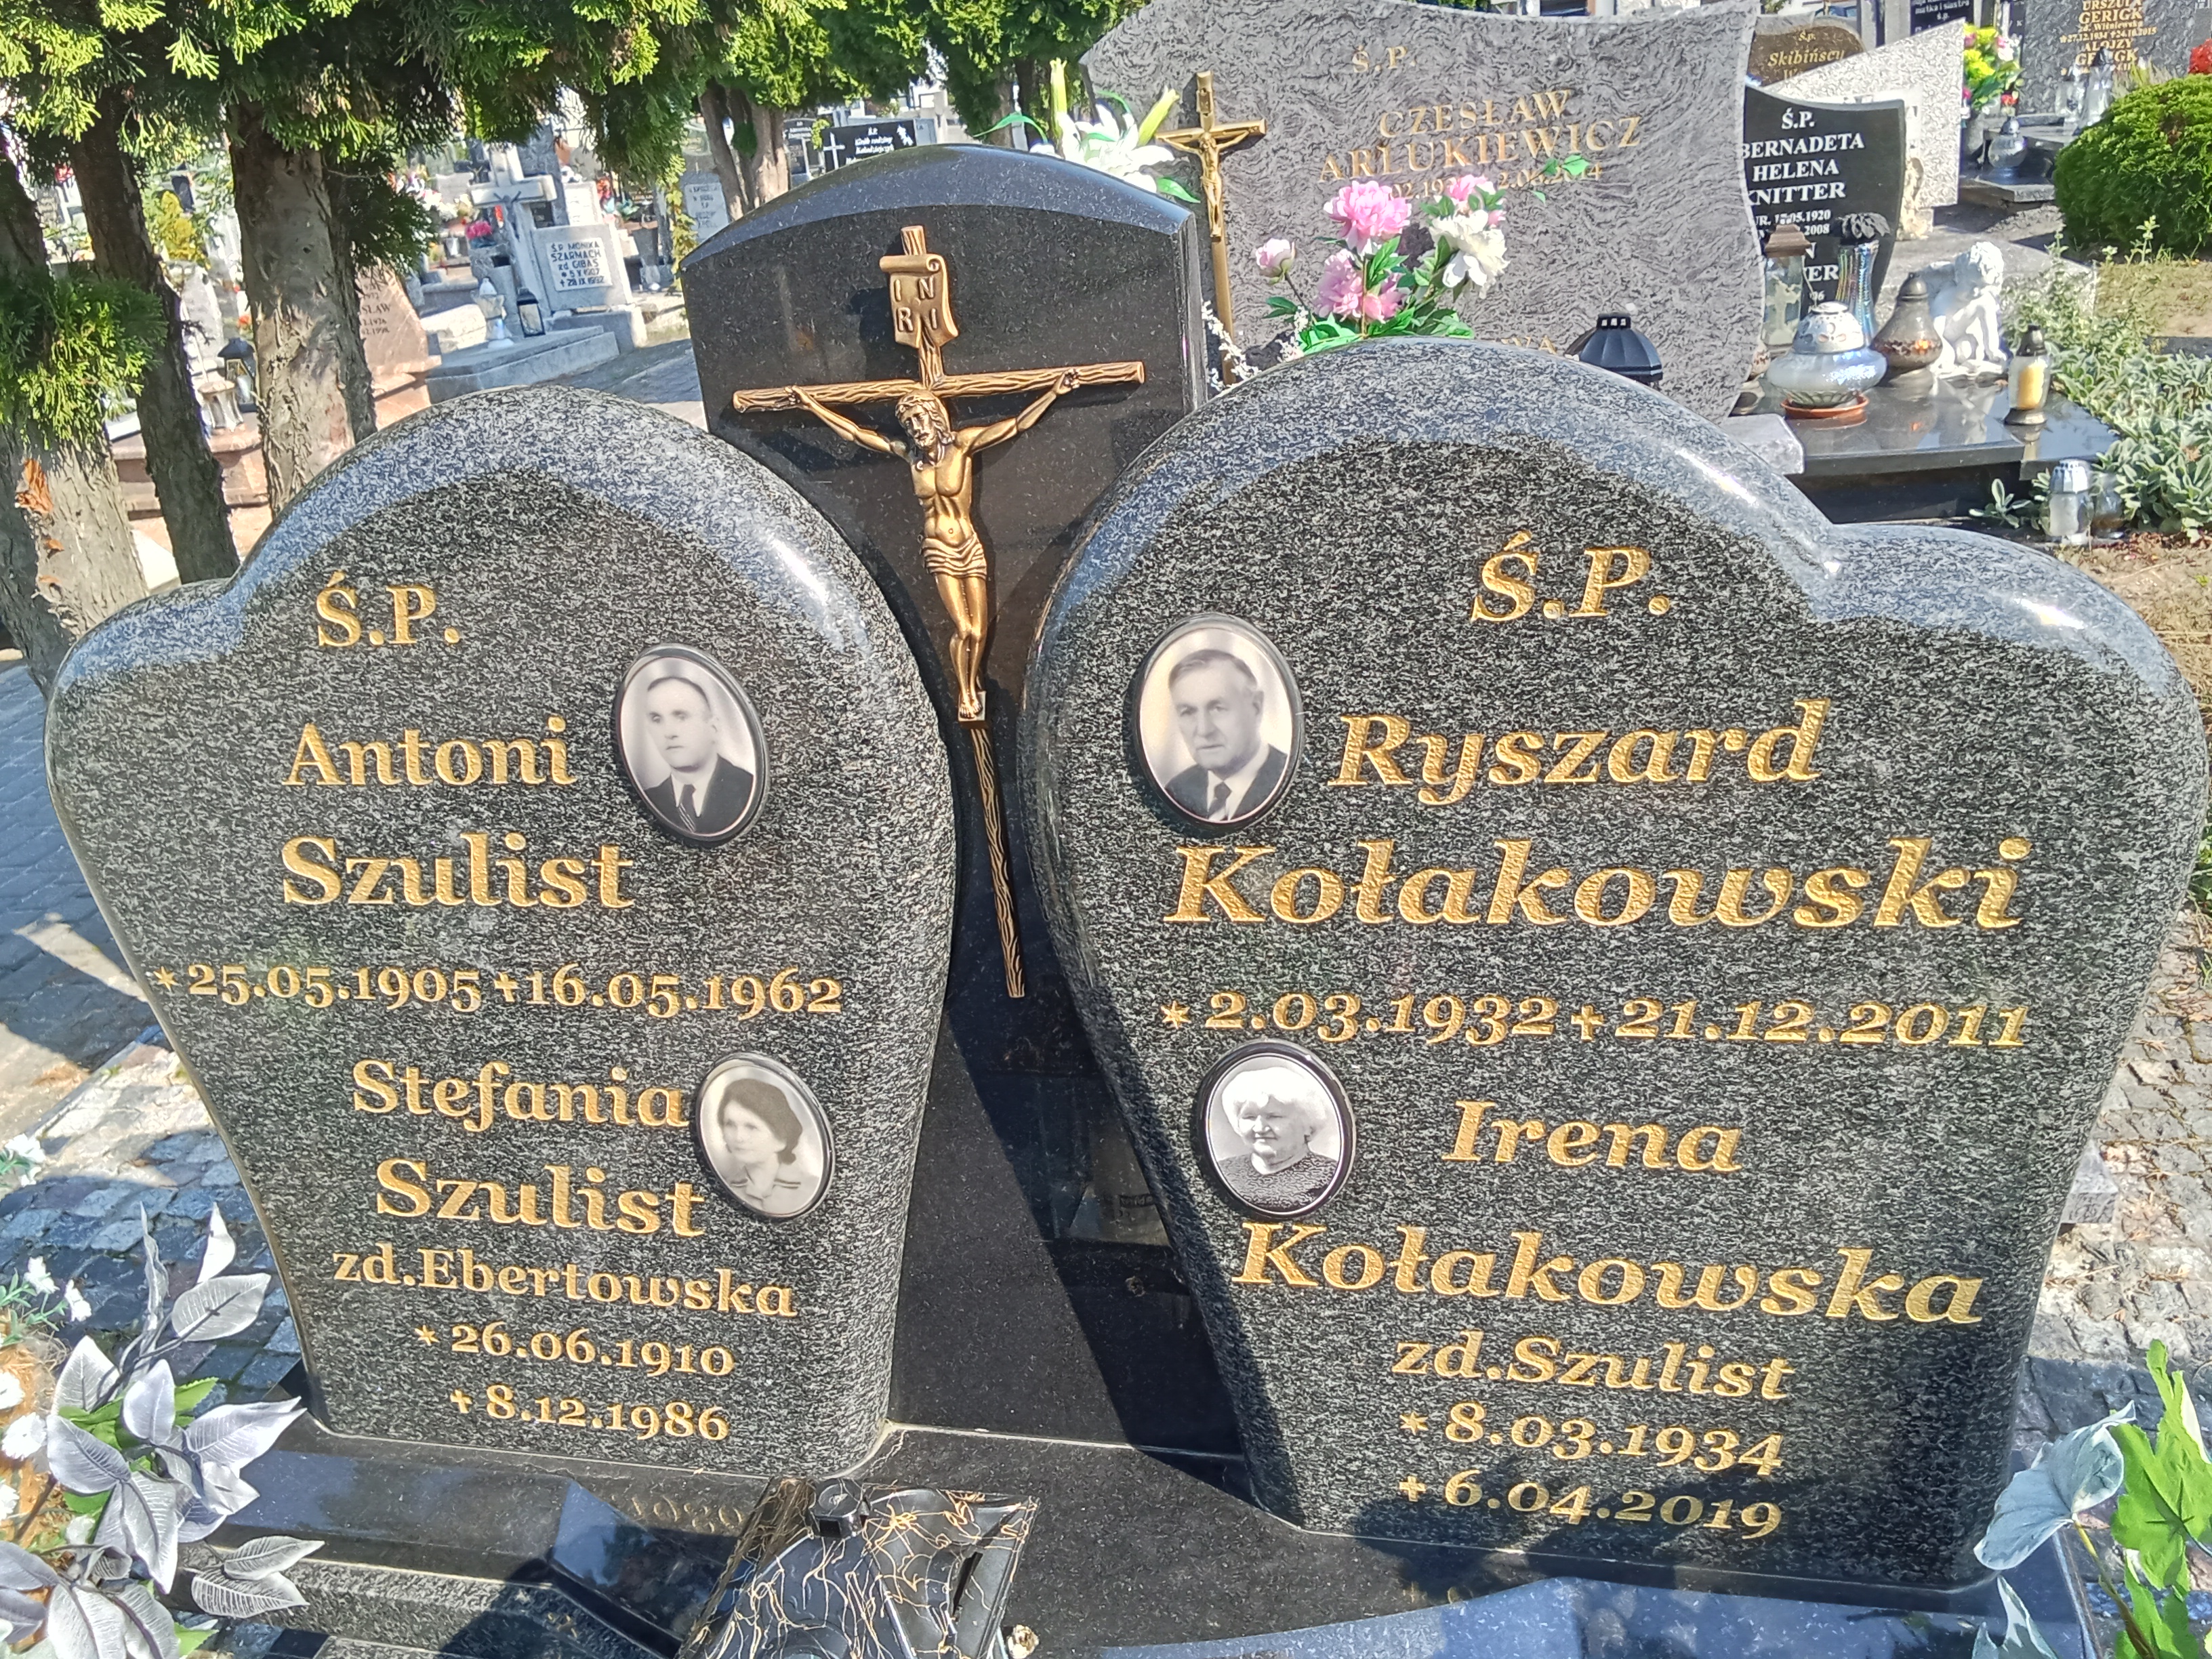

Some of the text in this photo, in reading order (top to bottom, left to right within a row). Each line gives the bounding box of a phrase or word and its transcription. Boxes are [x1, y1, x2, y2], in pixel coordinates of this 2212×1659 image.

[2078, 7, 2142, 24] GERIGK
[2085, 39, 2132, 52] ALOJZY
[2075, 47, 2139, 66] GEGK
[1379, 89, 1572, 138] CZESŁAW
[1741, 133, 1865, 159] BERNADETA
[1781, 107, 1816, 129] Ś.P.
[1751, 159, 1840, 182] HELENA
[550, 249, 602, 262] SZARMACH
[568, 241, 600, 250] MONIKA
[316, 569, 460, 649] Ś.P.
[1469, 529, 1672, 624] Ś.P.
[283, 714, 575, 787] Antoni
[1328, 697, 1831, 806] Ryszard
[282, 831, 634, 909] Szulist
[1163, 835, 2032, 932] Kołakowski
[188, 962, 844, 1017] 25.05.1905 16.05.1962
[1206, 989, 2028, 1050] 2.03.1932 21.12.2011
[352, 1059, 689, 1134] Stefania
[1442, 1099, 1742, 1174] Irena
[376, 1157, 705, 1238] Szulist
[333, 1243, 798, 1319] zd.Ebertowska
[1232, 1220, 1984, 1324] Kołakowska
[451, 1321, 736, 1377] 26.06.1910
[1391, 1328, 1795, 1401] zd.Szulist
[485, 1383, 731, 1442] 8.12.1986
[1444, 1400, 1782, 1476] 8.03.1934
[1443, 1469, 1782, 1539] 6.04.2019
